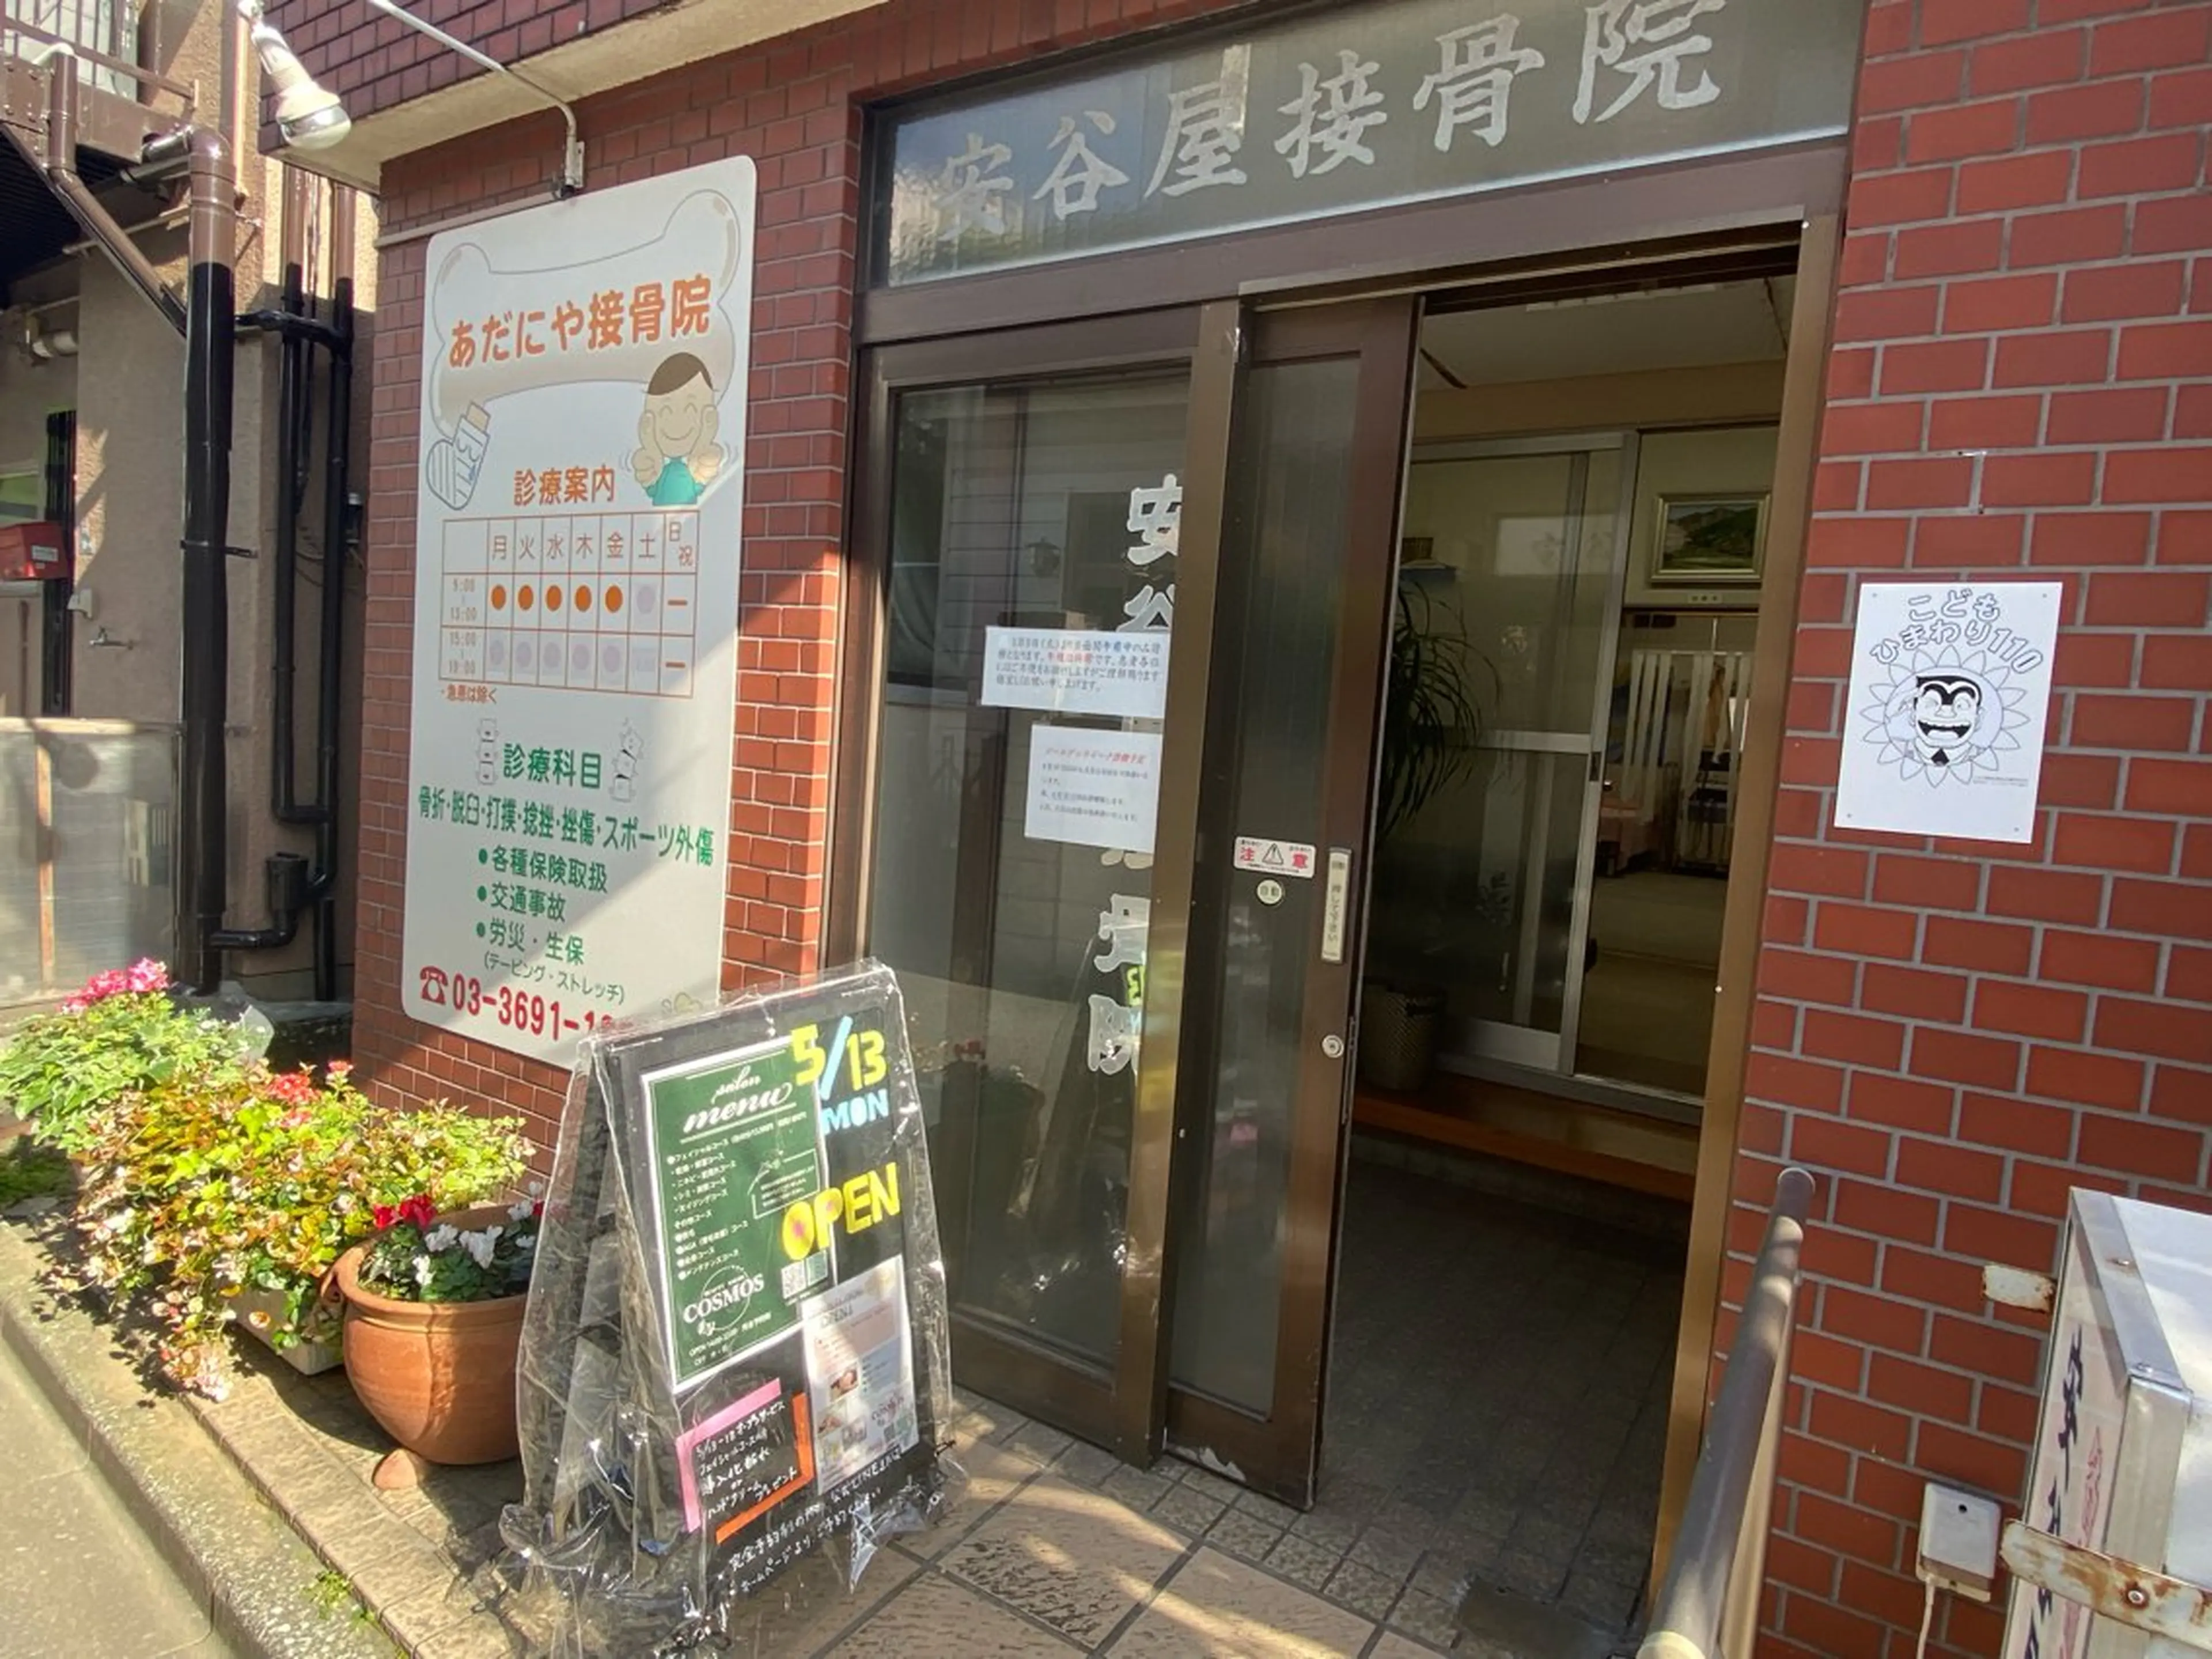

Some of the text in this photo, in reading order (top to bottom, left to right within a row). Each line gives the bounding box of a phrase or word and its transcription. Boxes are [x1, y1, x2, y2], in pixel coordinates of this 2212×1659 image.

[938, 0, 1728, 243] 安谷屋接骨院
[449, 273, 712, 369] あだにや接骨院
[513, 464, 615, 507] 診療案内
[492, 521, 694, 567] 月 火 水 木 金 土 日 祝
[1908, 588, 2001, 622] こども
[1869, 619, 2044, 674] ひまわり110
[502, 743, 601, 790] 診療科目
[491, 843, 608, 895] 各種保険取扱
[490, 881, 566, 923] 交通事故
[791, 1016, 888, 1100] 5/13
[683, 1082, 793, 1133] menu
[821, 1089, 888, 1135] MON
[782, 1161, 900, 1260] OPEN
[683, 1273, 765, 1324] COSMOS
